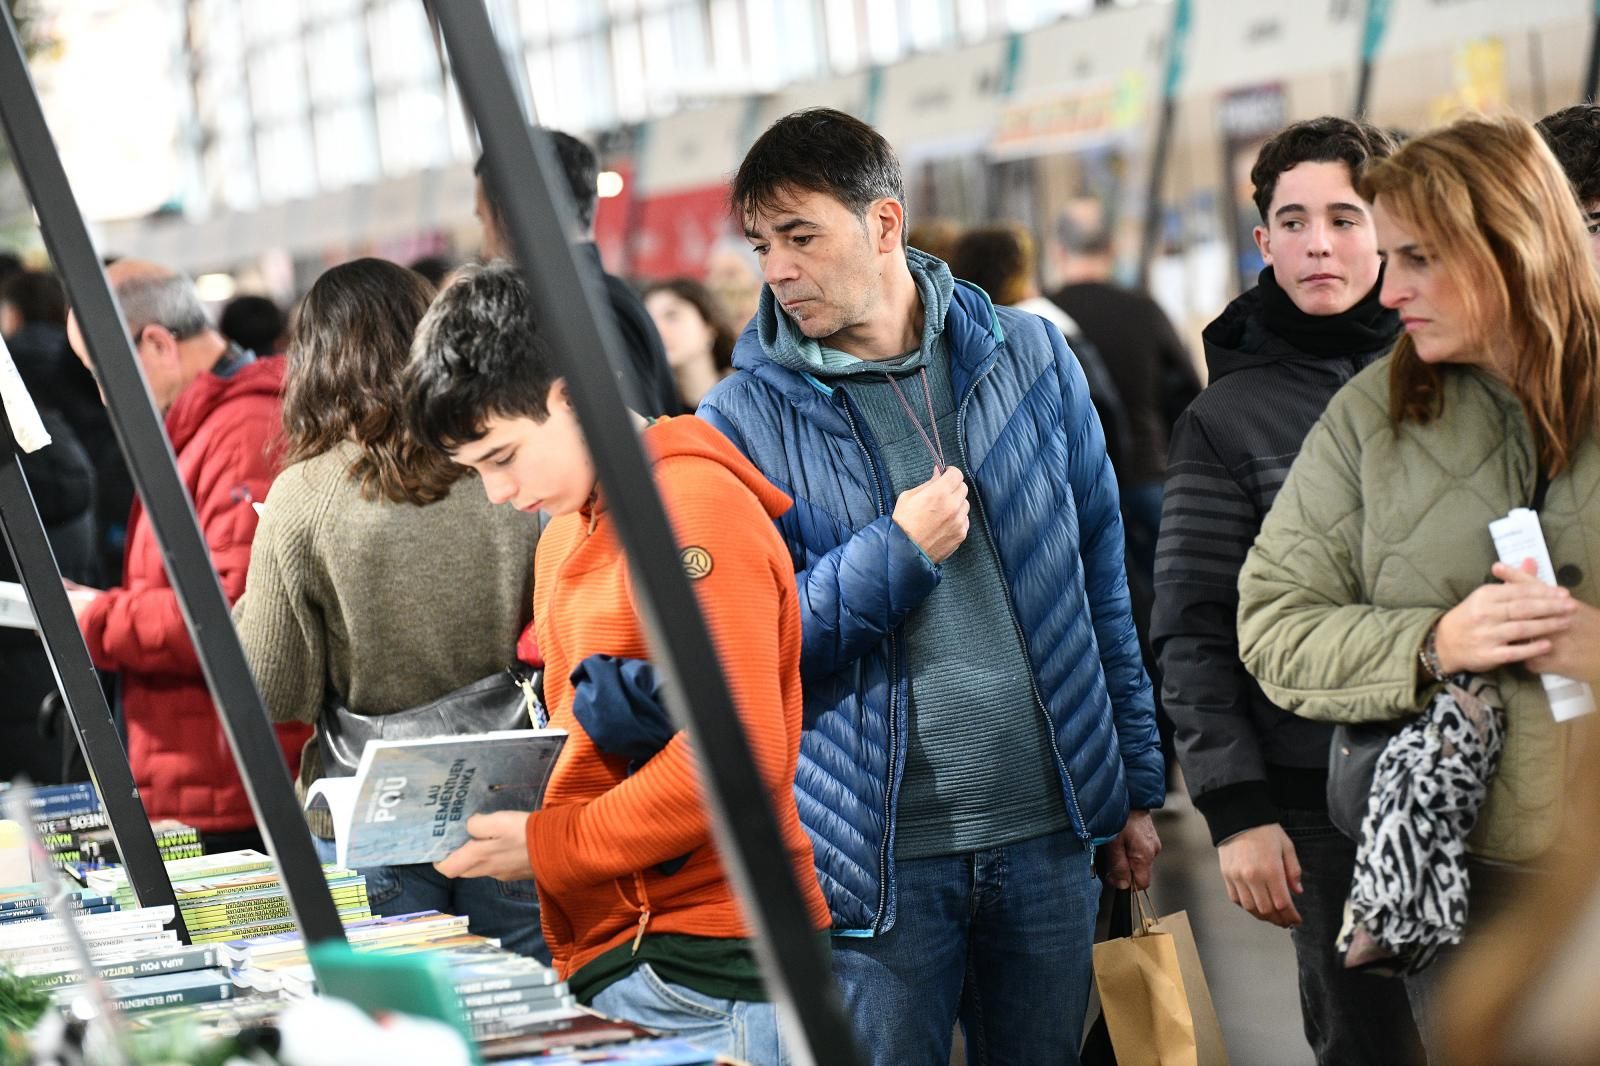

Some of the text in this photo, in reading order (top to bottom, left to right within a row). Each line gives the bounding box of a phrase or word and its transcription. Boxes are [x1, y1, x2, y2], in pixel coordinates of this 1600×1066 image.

[374, 776, 407, 823] POU
[424, 785, 441, 806] LAU
[432, 758, 466, 837] ELEMENTUEN
[449, 767, 476, 822] ERRONKA
[140, 961, 160, 972] POU
[161, 958, 184, 969] AUPA
[111, 993, 183, 1010] LAU ELEMENTUE
